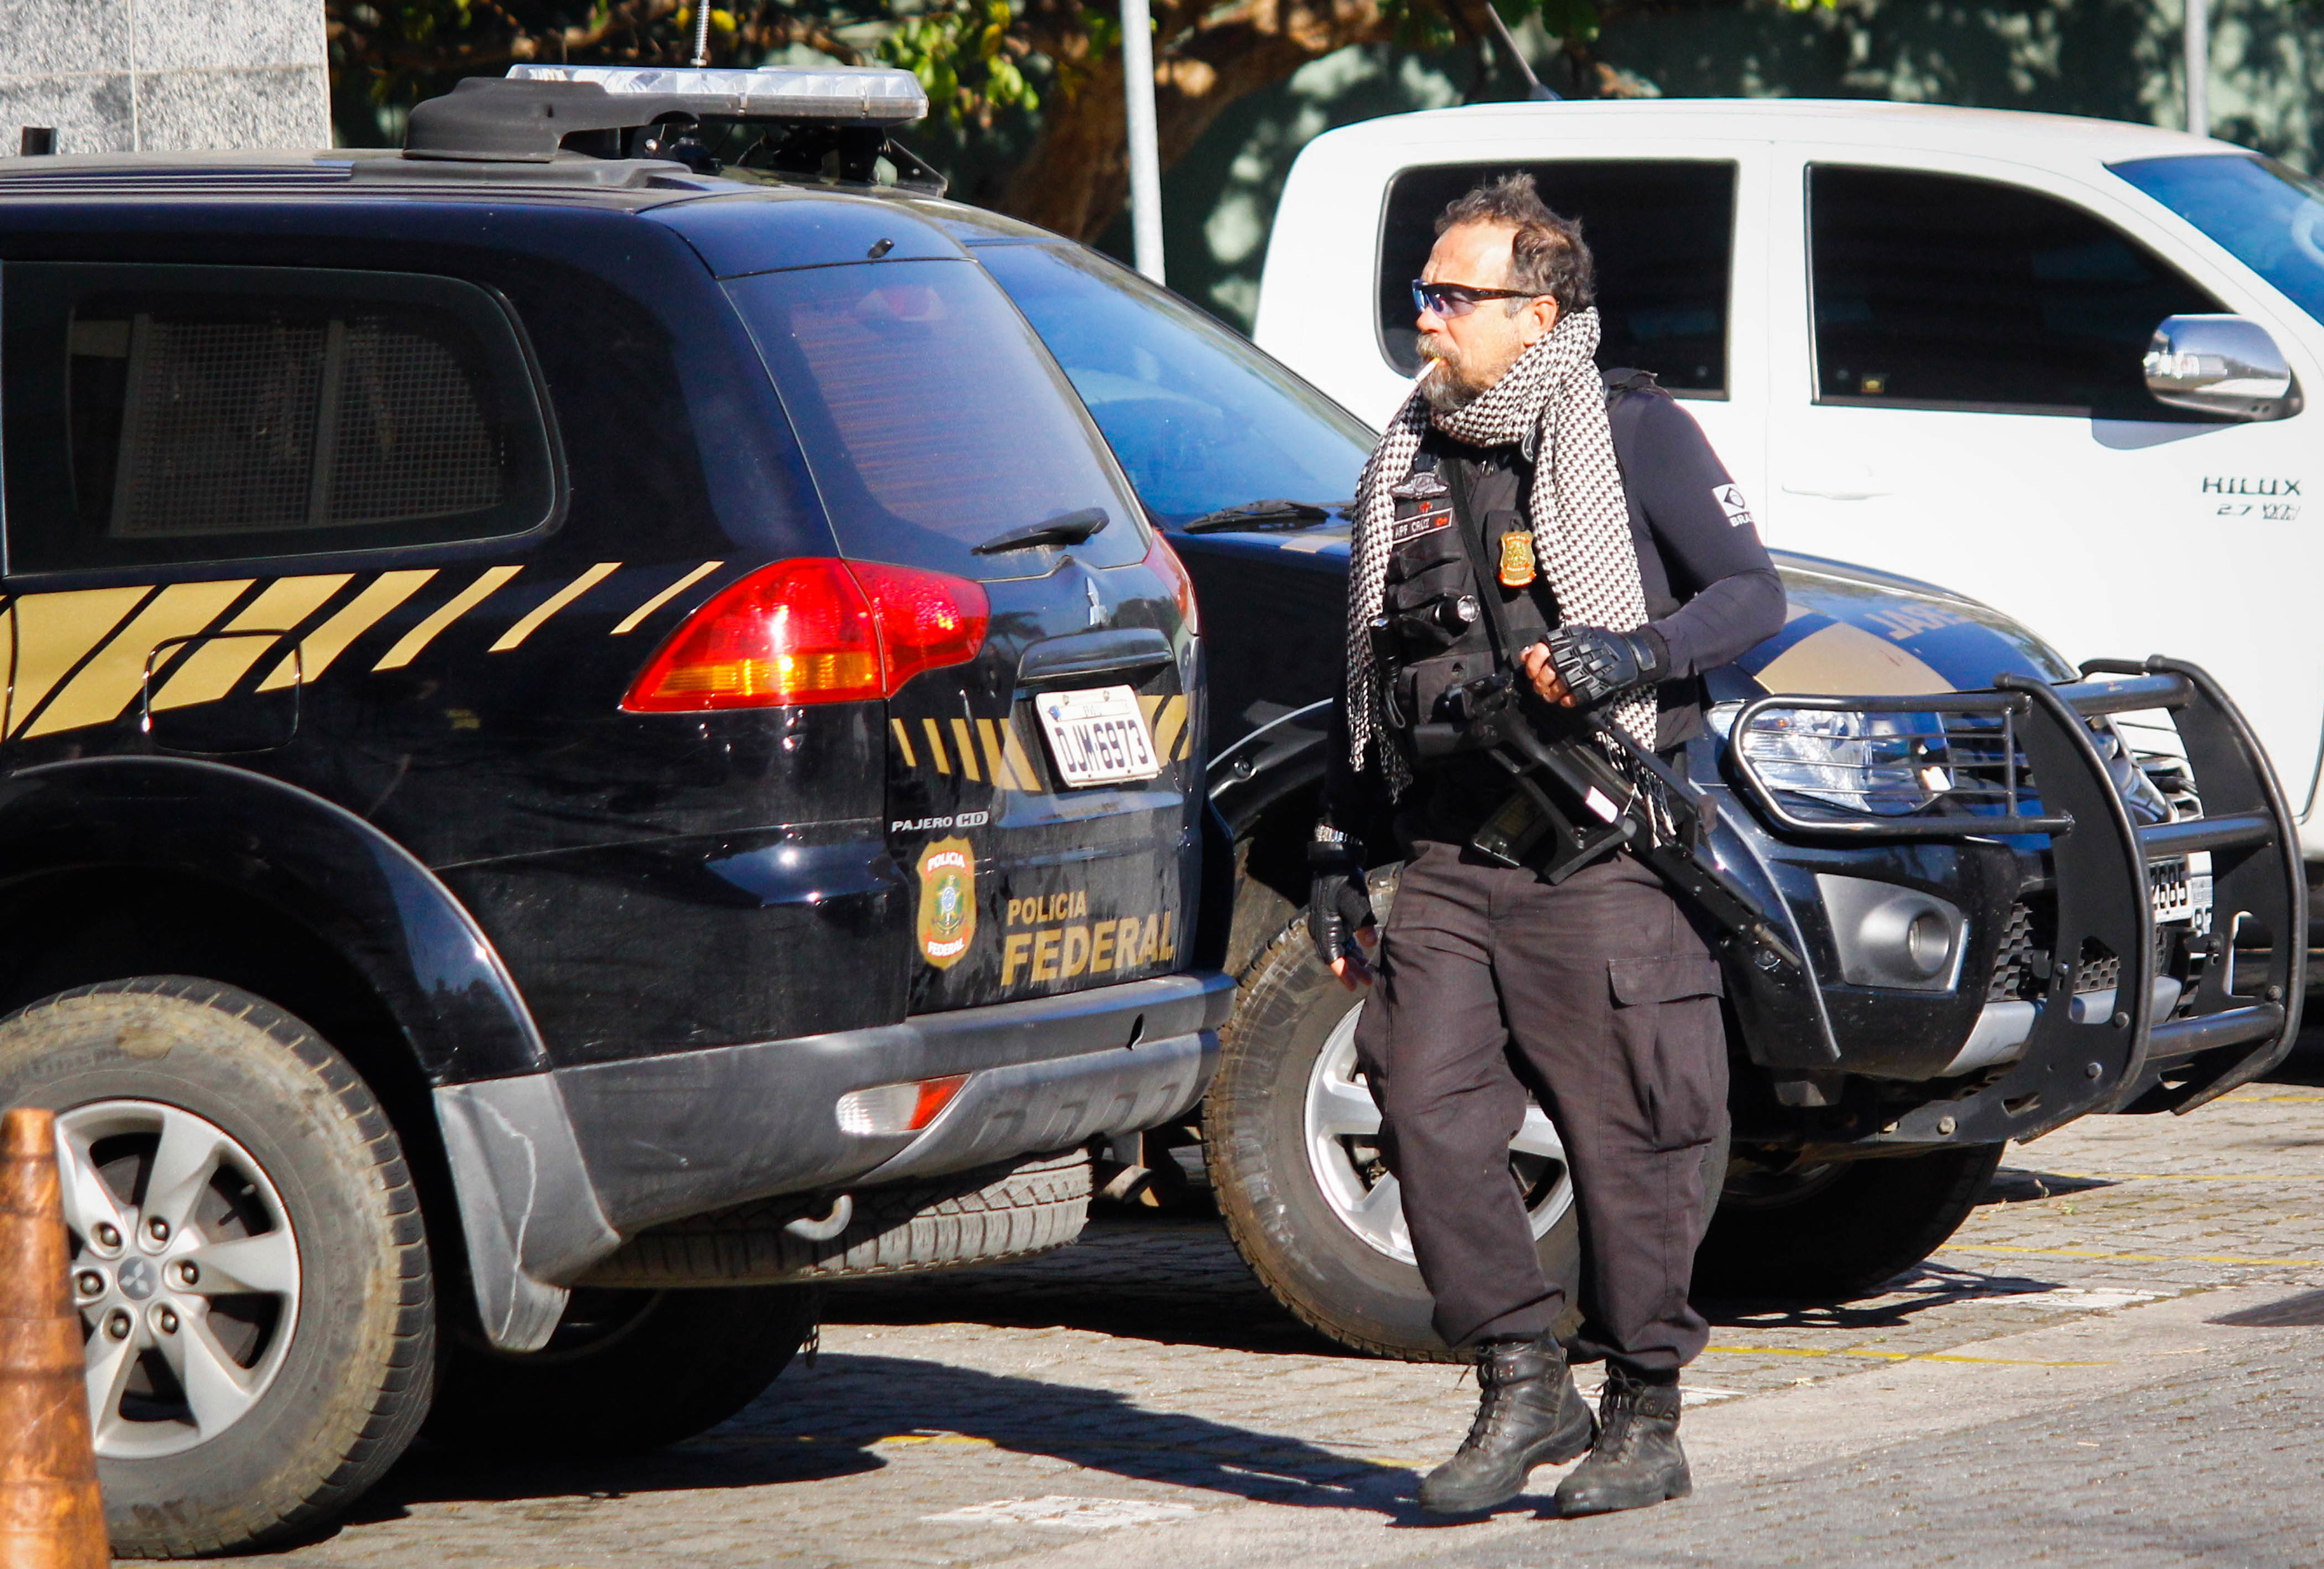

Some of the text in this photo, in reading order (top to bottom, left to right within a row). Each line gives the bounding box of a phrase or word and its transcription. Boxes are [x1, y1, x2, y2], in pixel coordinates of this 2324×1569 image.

[2203, 476, 2301, 496] HILUX
[1411, 518, 1430, 532] CRUZ
[891, 812, 985, 832] PAJERO HD
[927, 938, 965, 957] FEDERAL
[1001, 911, 1173, 986] FEDERAL
